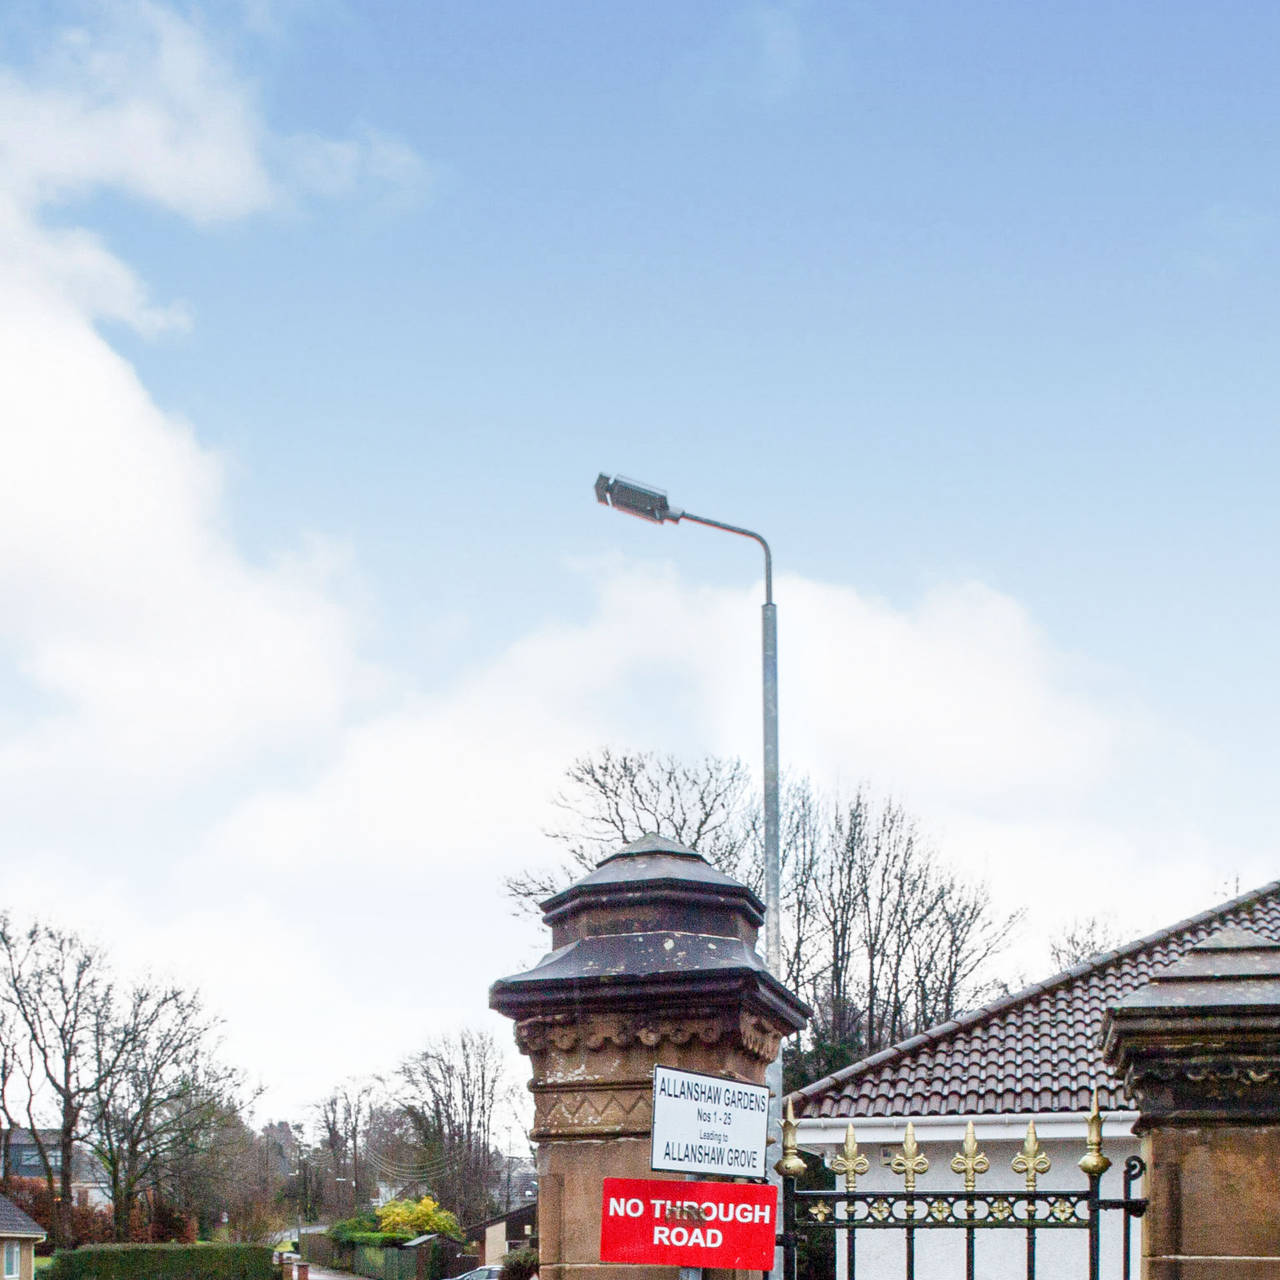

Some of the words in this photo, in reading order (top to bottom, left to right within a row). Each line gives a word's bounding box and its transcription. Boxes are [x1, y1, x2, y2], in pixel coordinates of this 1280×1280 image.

[659, 1077, 722, 1105] ALLANSHAW
[724, 1088, 767, 1112] GARDENS
[697, 1107, 711, 1122] Nos
[723, 1111, 732, 1125] 25
[699, 1129, 721, 1144] Leading
[722, 1132, 729, 1142] to
[663, 1141, 725, 1166] ALLANSHAW
[727, 1148, 758, 1168] GROVE
[608, 1197, 644, 1217] NO
[650, 1199, 770, 1224] THROUGH
[652, 1226, 723, 1248] ROAD
